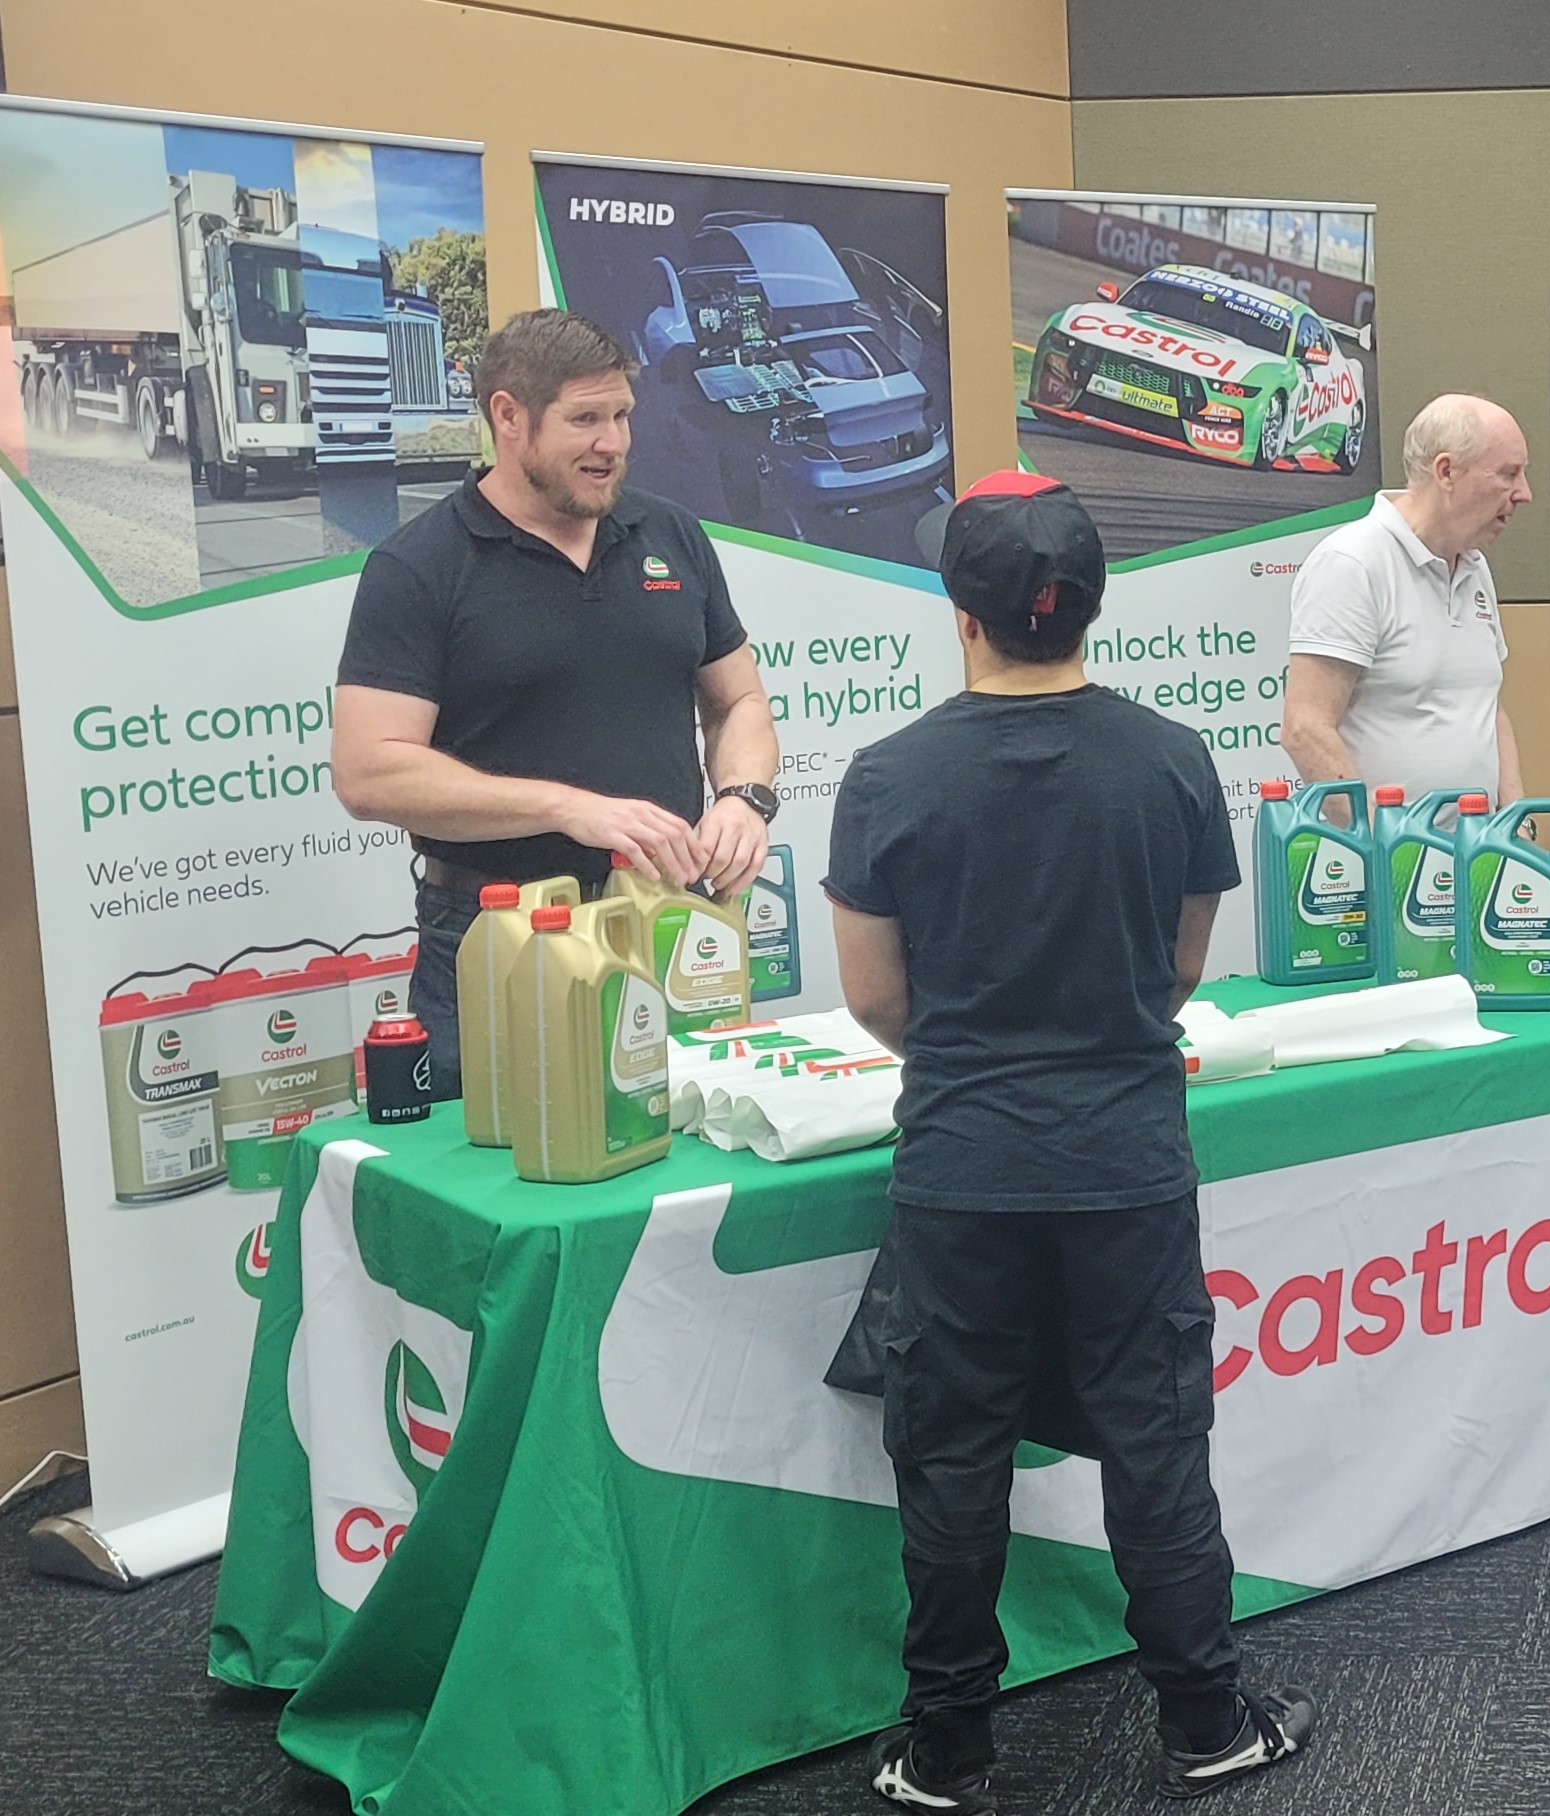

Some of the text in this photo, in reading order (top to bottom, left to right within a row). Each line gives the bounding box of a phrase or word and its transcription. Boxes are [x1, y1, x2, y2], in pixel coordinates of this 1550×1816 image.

[569, 196, 676, 228] HYBRID
[1096, 217, 1181, 268] Coates
[1069, 314, 1237, 378] Castrol
[1121, 388, 1173, 413] ultimate
[1191, 424, 1240, 445] RYCO
[1265, 562, 1302, 575] Castr
[807, 633, 911, 671] every
[1196, 621, 1257, 657] the
[768, 673, 922, 728] a hybrid
[1153, 671, 1246, 714] edge
[1257, 664, 1290, 701] of
[73, 685, 334, 752] Get compl
[79, 754, 337, 833] protection
[86, 828, 410, 887] We've got every fluid your
[90, 874, 271, 920] vehicle needs.
[1320, 880, 1350, 891] Castrol
[1427, 893, 1456, 902] Castro
[1419, 907, 1456, 916] MAGNAT
[1506, 906, 1539, 915] Castrol
[1497, 920, 1548, 929] MAGNATEC
[691, 960, 725, 972] Castrol
[262, 1044, 308, 1063] Castrol
[152, 1059, 190, 1077] Castrol
[144, 1077, 203, 1101] TRANSMAX
[255, 1069, 318, 1097] VECTON
[276, 1113, 310, 1131] 15W-40
[124, 1314, 195, 1342] castrol.com.au
